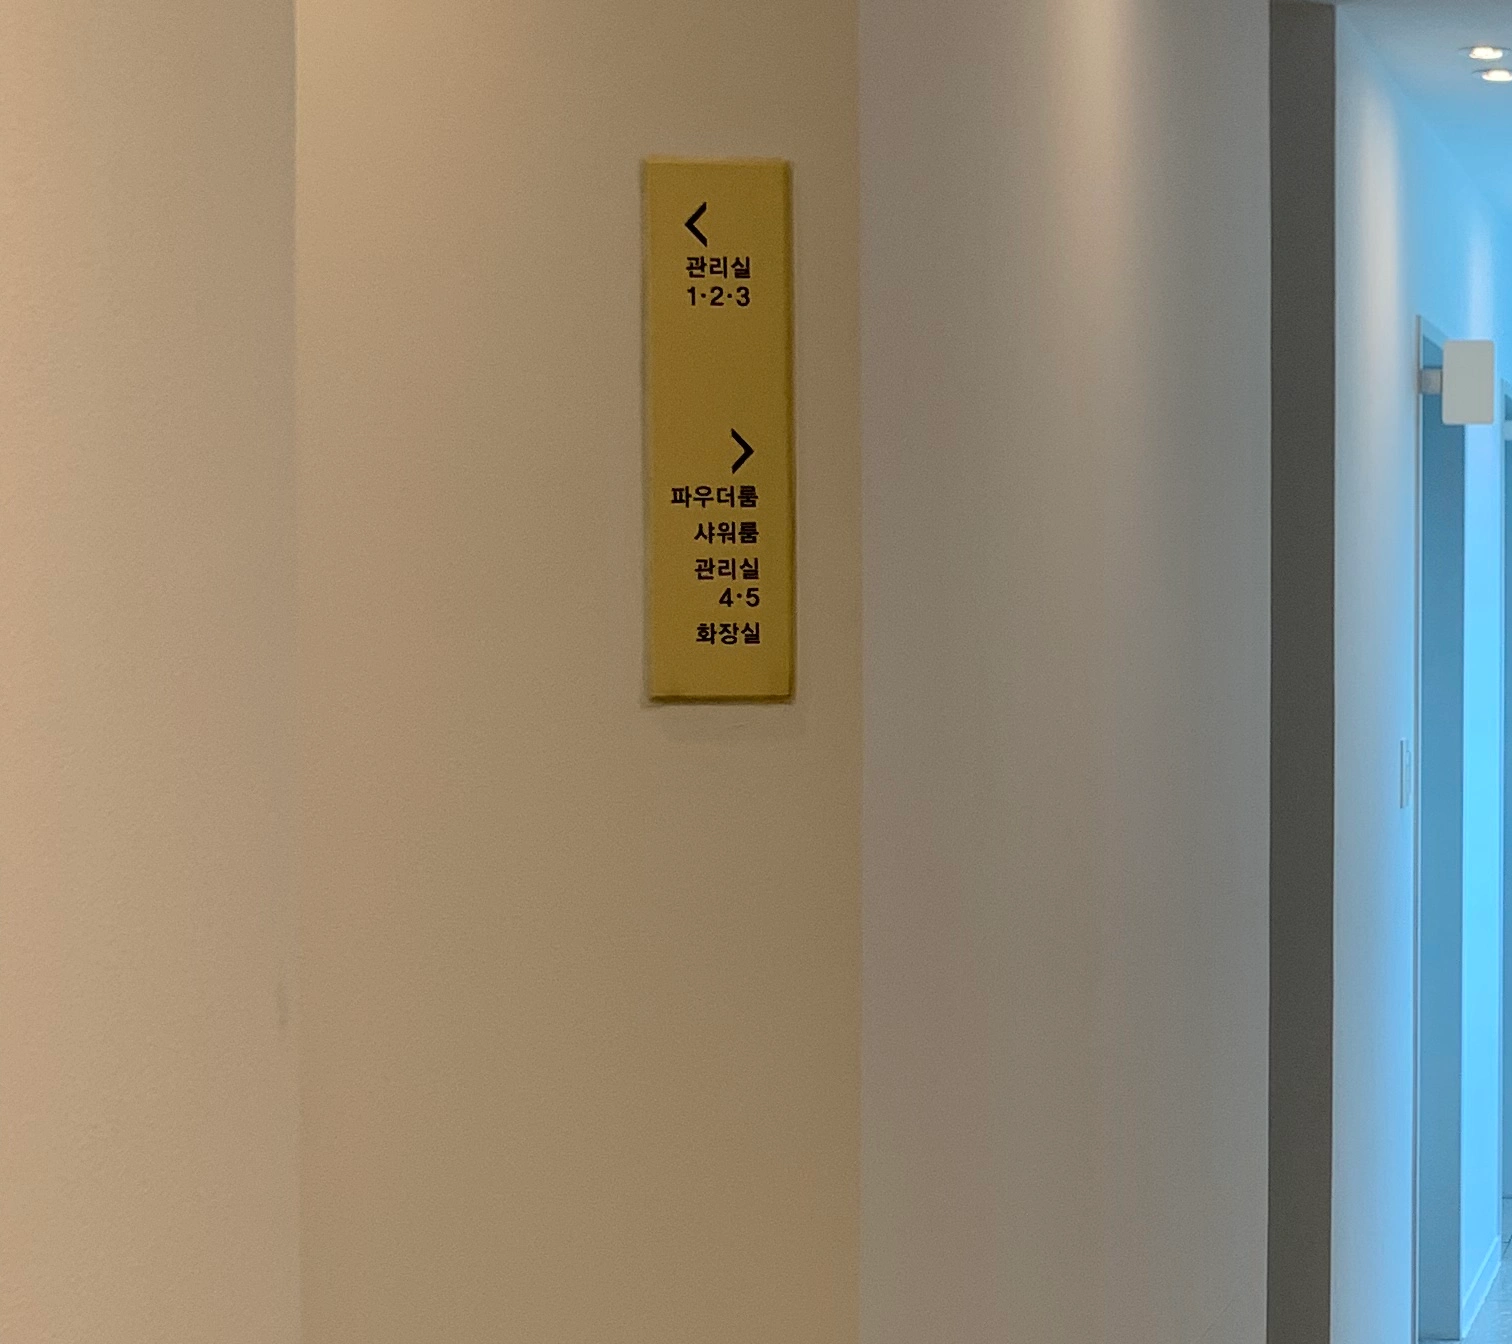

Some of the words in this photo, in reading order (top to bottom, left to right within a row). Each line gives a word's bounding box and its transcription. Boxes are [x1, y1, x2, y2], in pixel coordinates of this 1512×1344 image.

[685, 255, 751, 280] 관리실
[670, 484, 759, 509] 파우더룸
[693, 520, 760, 545] 샤워룸
[694, 557, 760, 581] 관리실
[695, 621, 761, 646] 화장실
